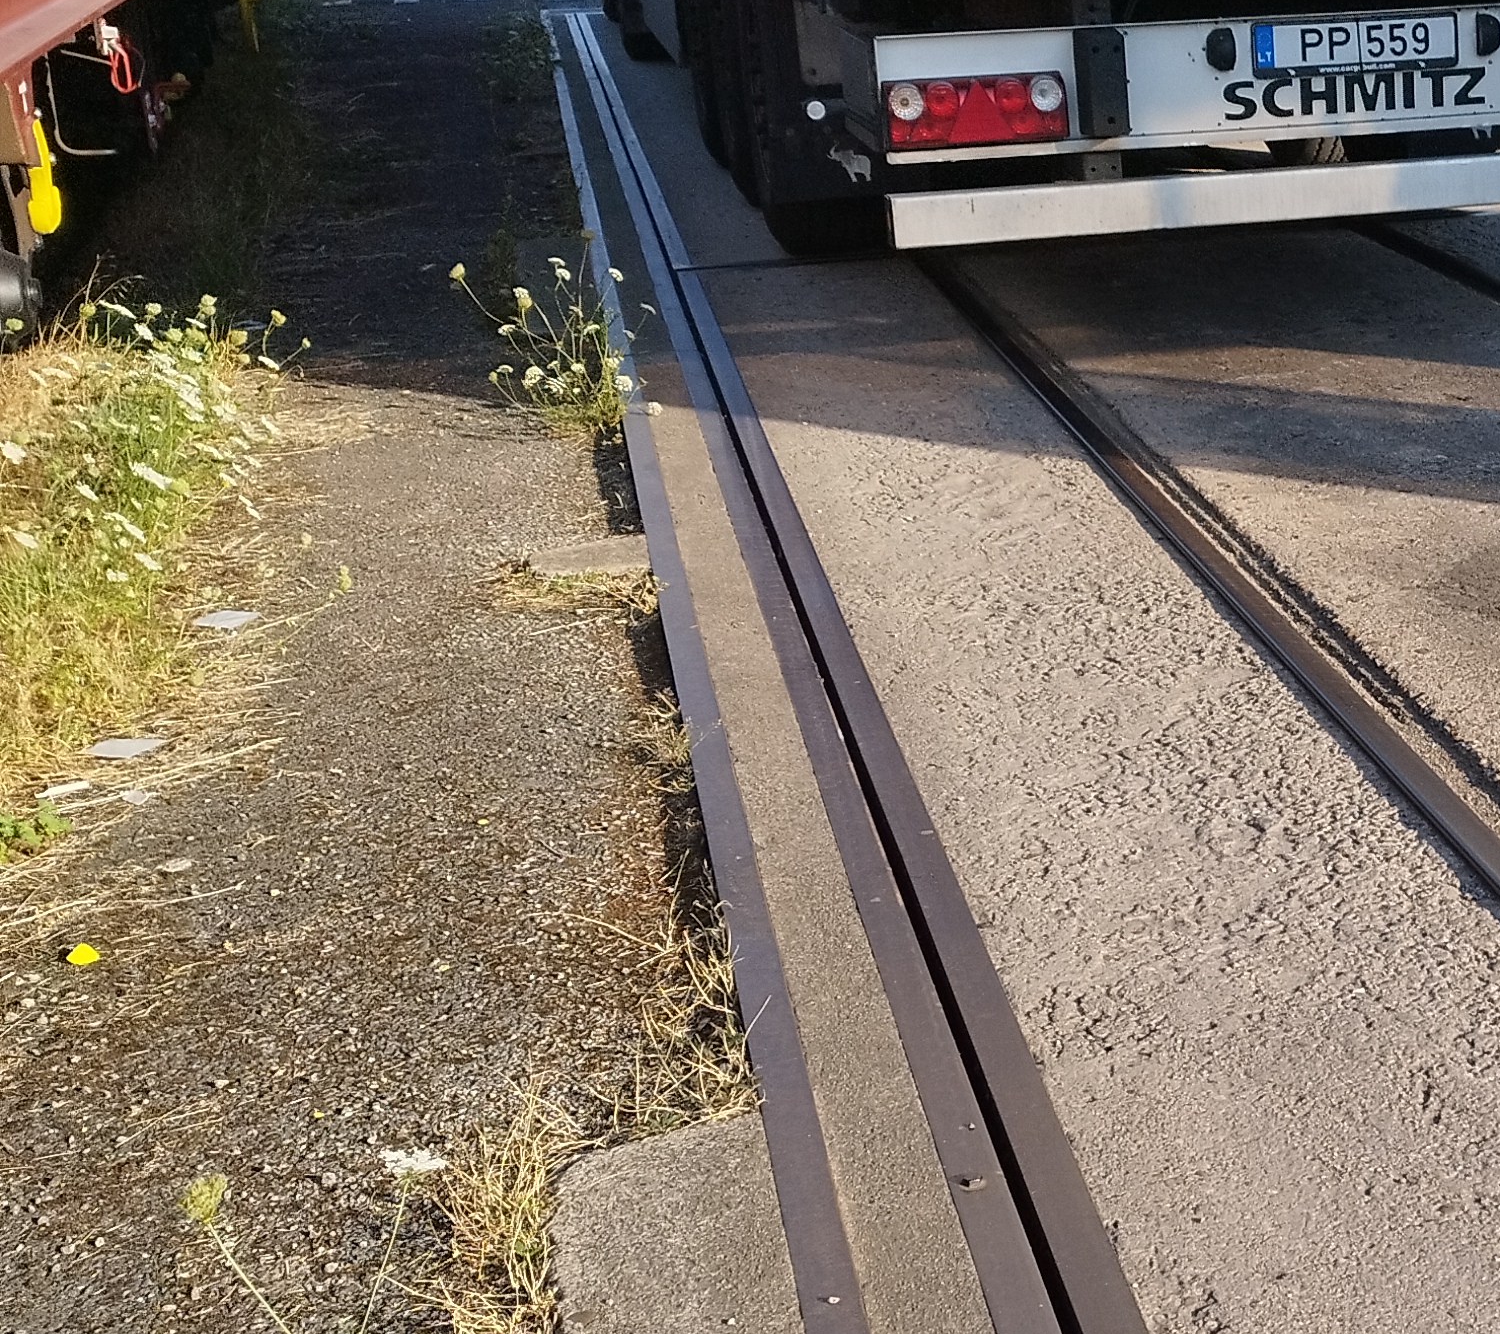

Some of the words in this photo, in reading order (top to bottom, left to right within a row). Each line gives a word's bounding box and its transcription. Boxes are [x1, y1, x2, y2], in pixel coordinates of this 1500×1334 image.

[1257, 50, 1272, 63] LT
[1300, 26, 1351, 62] PP
[1366, 22, 1430, 58] 559
[1222, 66, 1487, 121] SCHMITZ
